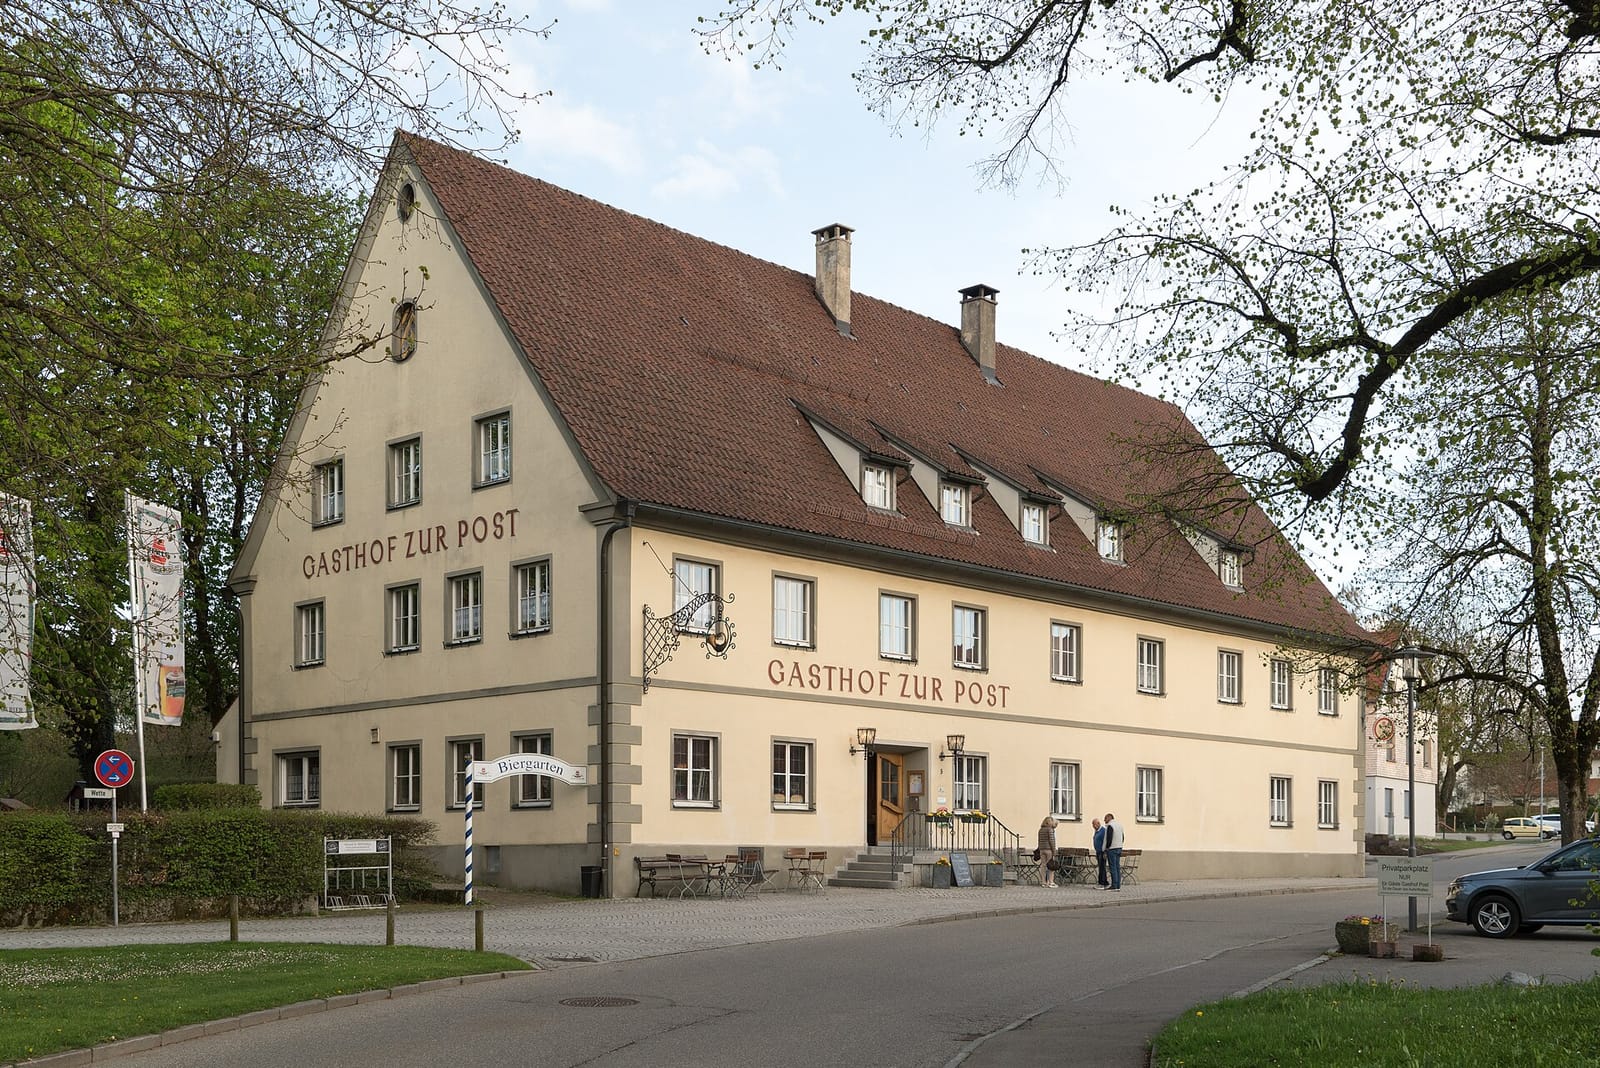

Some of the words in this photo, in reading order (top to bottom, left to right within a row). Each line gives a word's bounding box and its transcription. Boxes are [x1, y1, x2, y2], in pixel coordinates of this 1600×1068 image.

[302, 535, 398, 579] GASTHOF
[404, 525, 448, 558] ZUR
[457, 508, 520, 548] POST
[768, 659, 891, 696] GASTHOF
[898, 673, 944, 702] ZUR
[955, 680, 1010, 708] POST
[498, 760, 563, 775] Biergarten
[1381, 864, 1428, 873] Privatparkplatz
